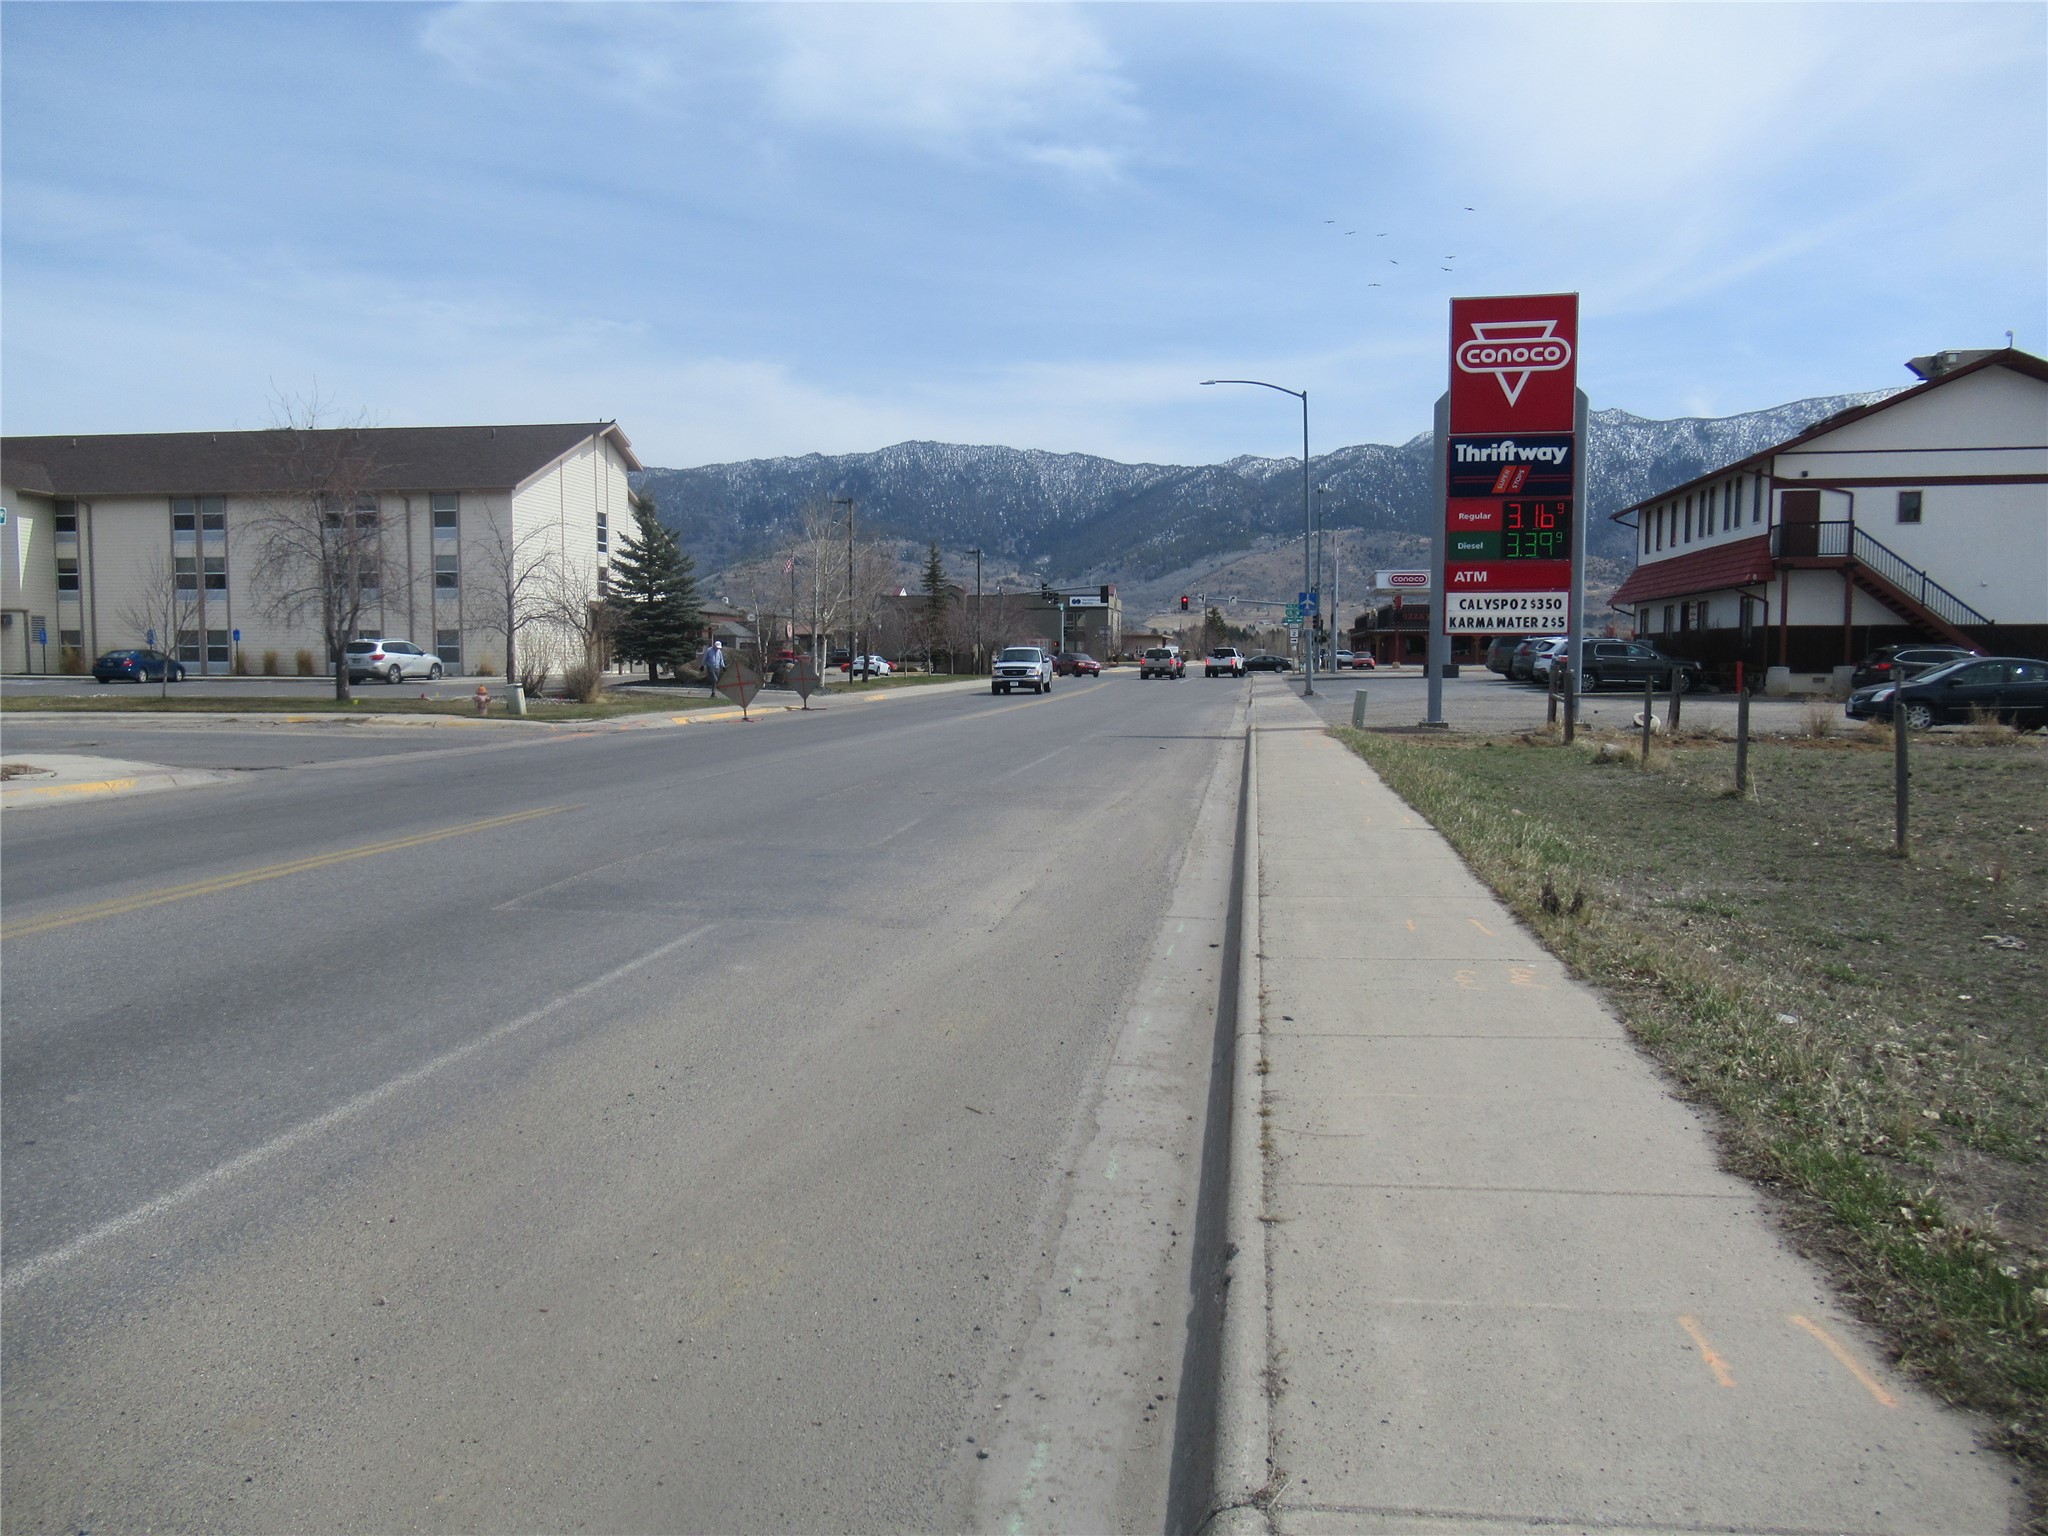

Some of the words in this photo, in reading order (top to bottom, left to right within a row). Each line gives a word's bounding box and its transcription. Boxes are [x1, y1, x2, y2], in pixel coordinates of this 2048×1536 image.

[1466, 346, 1561, 363] conoco
[1455, 440, 1568, 465] Thriftway
[1458, 512, 1492, 521] Regular
[1457, 542, 1484, 550] Diesel
[1454, 571, 1488, 583] ATM
[1459, 599, 1519, 610] CALYSPO
[1449, 617, 1494, 628] KARMA
[1496, 617, 1538, 628] WATER
